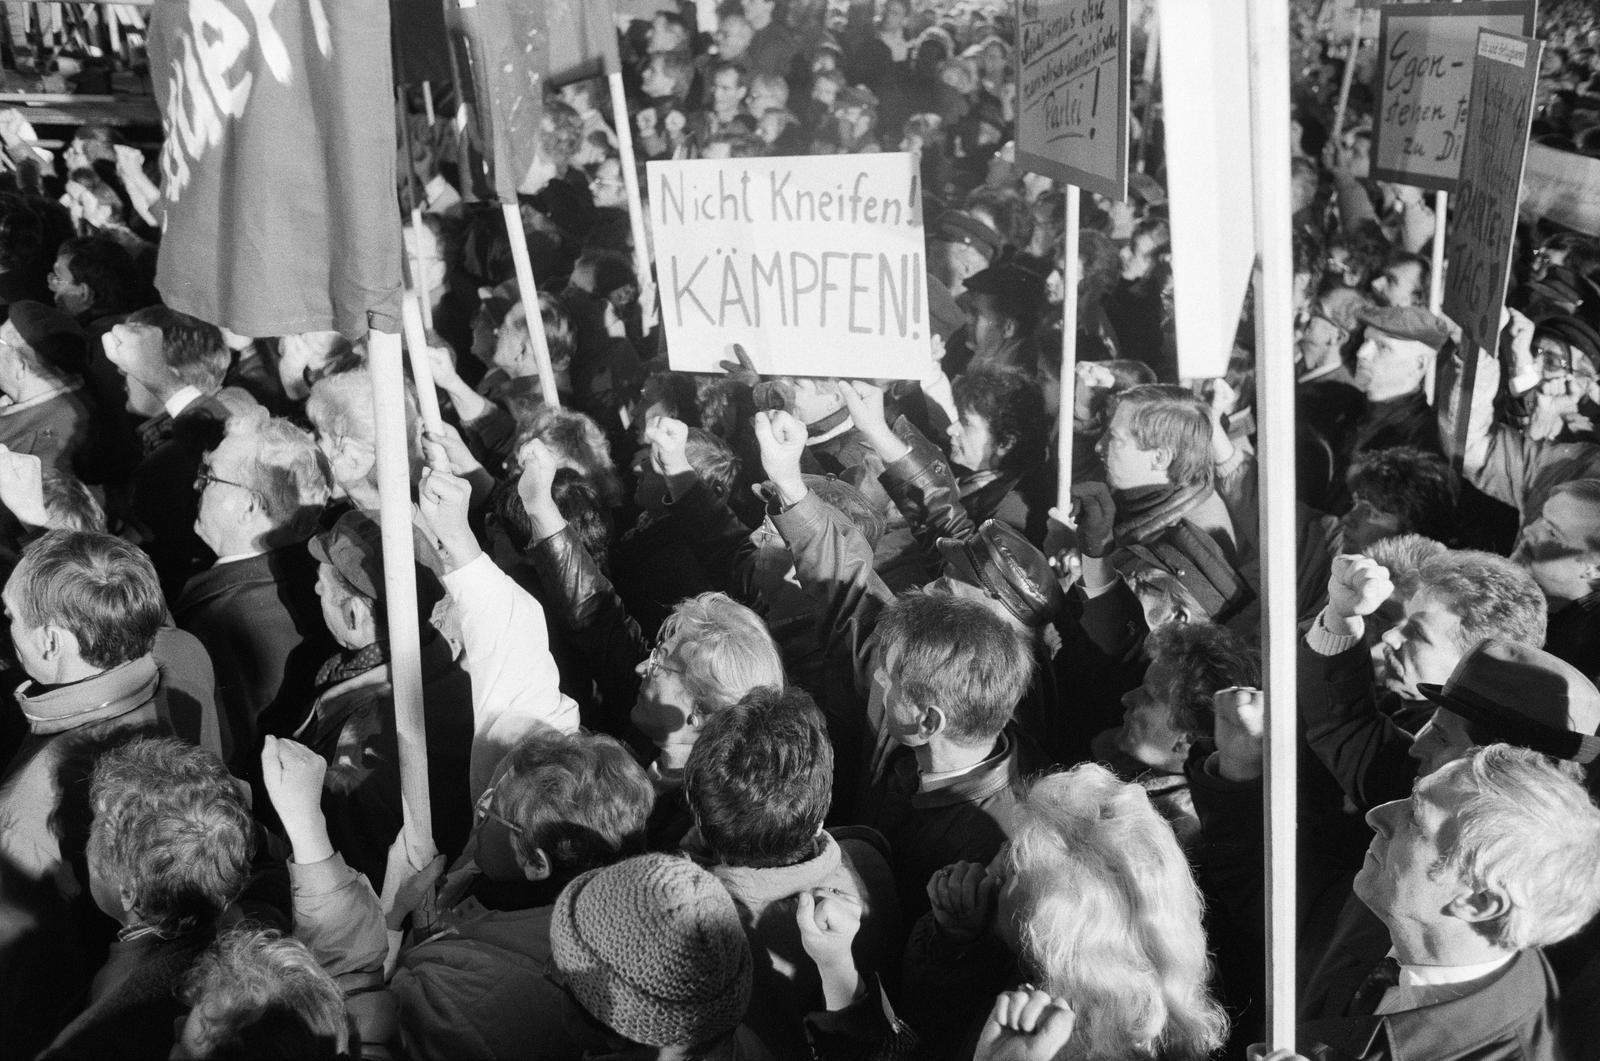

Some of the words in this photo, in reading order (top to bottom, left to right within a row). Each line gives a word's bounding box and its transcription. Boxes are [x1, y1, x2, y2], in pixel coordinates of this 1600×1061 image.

[1082, 0, 1105, 27] ohne
[1403, 136, 1426, 157] zu
[1435, 130, 1463, 162] Di
[661, 168, 754, 226] Nicht
[769, 170, 918, 226] Kneifen!
[670, 247, 922, 341] KÄMPFEN!
